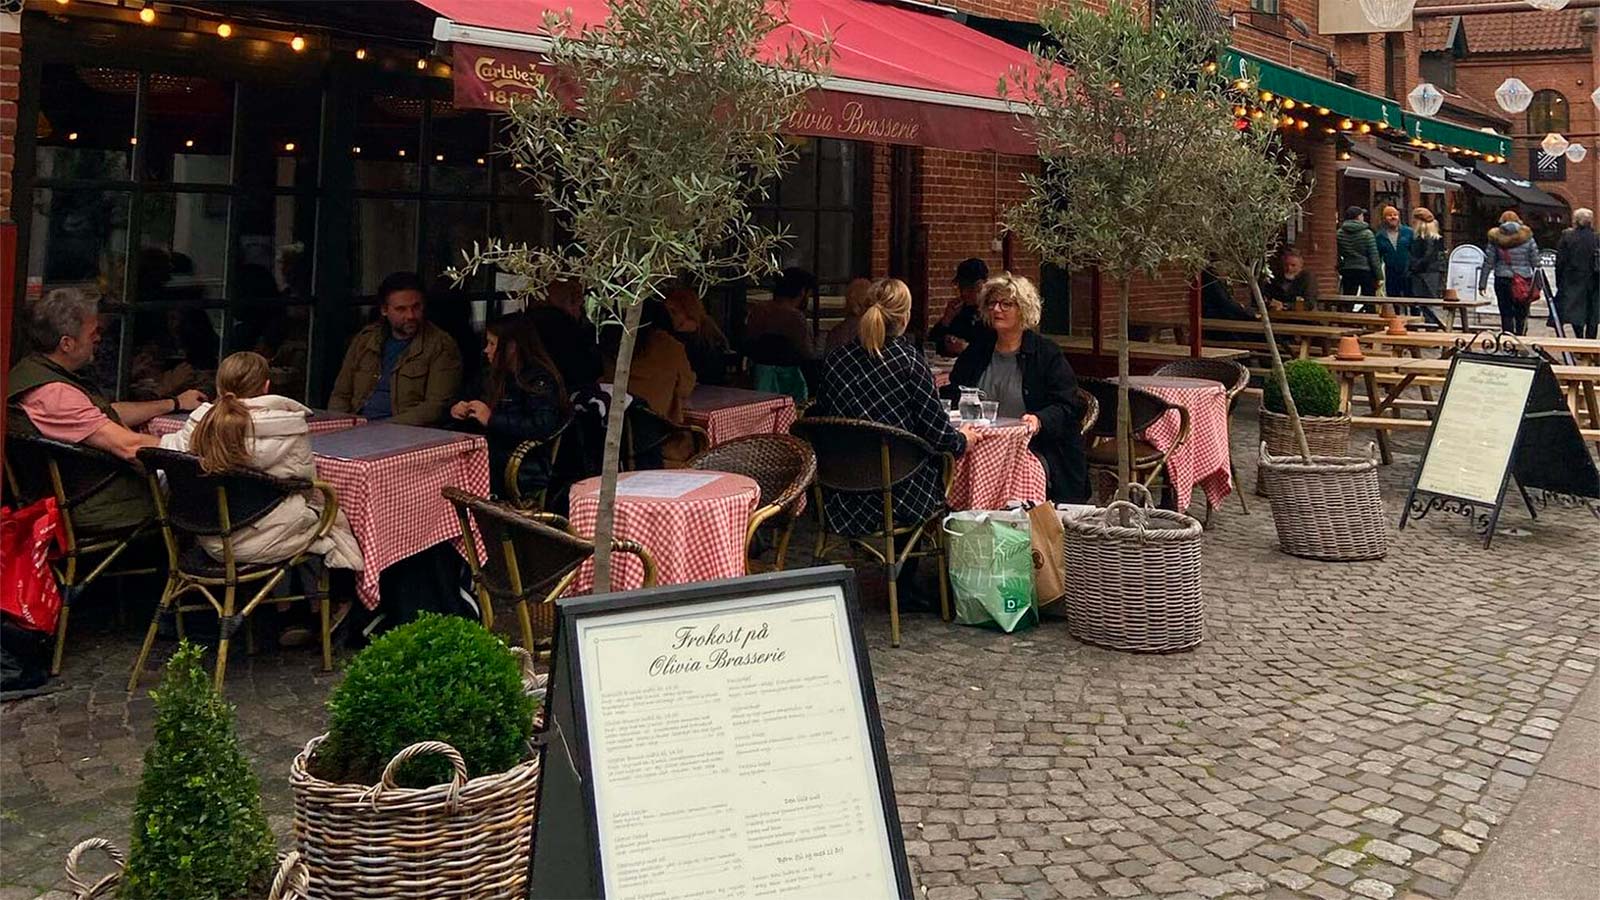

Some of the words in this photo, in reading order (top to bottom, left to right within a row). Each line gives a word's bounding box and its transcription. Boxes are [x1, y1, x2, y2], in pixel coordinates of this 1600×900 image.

[838, 101, 921, 140] Brasserie
[671, 623, 743, 650] Frokost
[740, 622, 770, 649] på
[648, 654, 702, 677] Olivia
[705, 647, 787, 670] Brasserie
